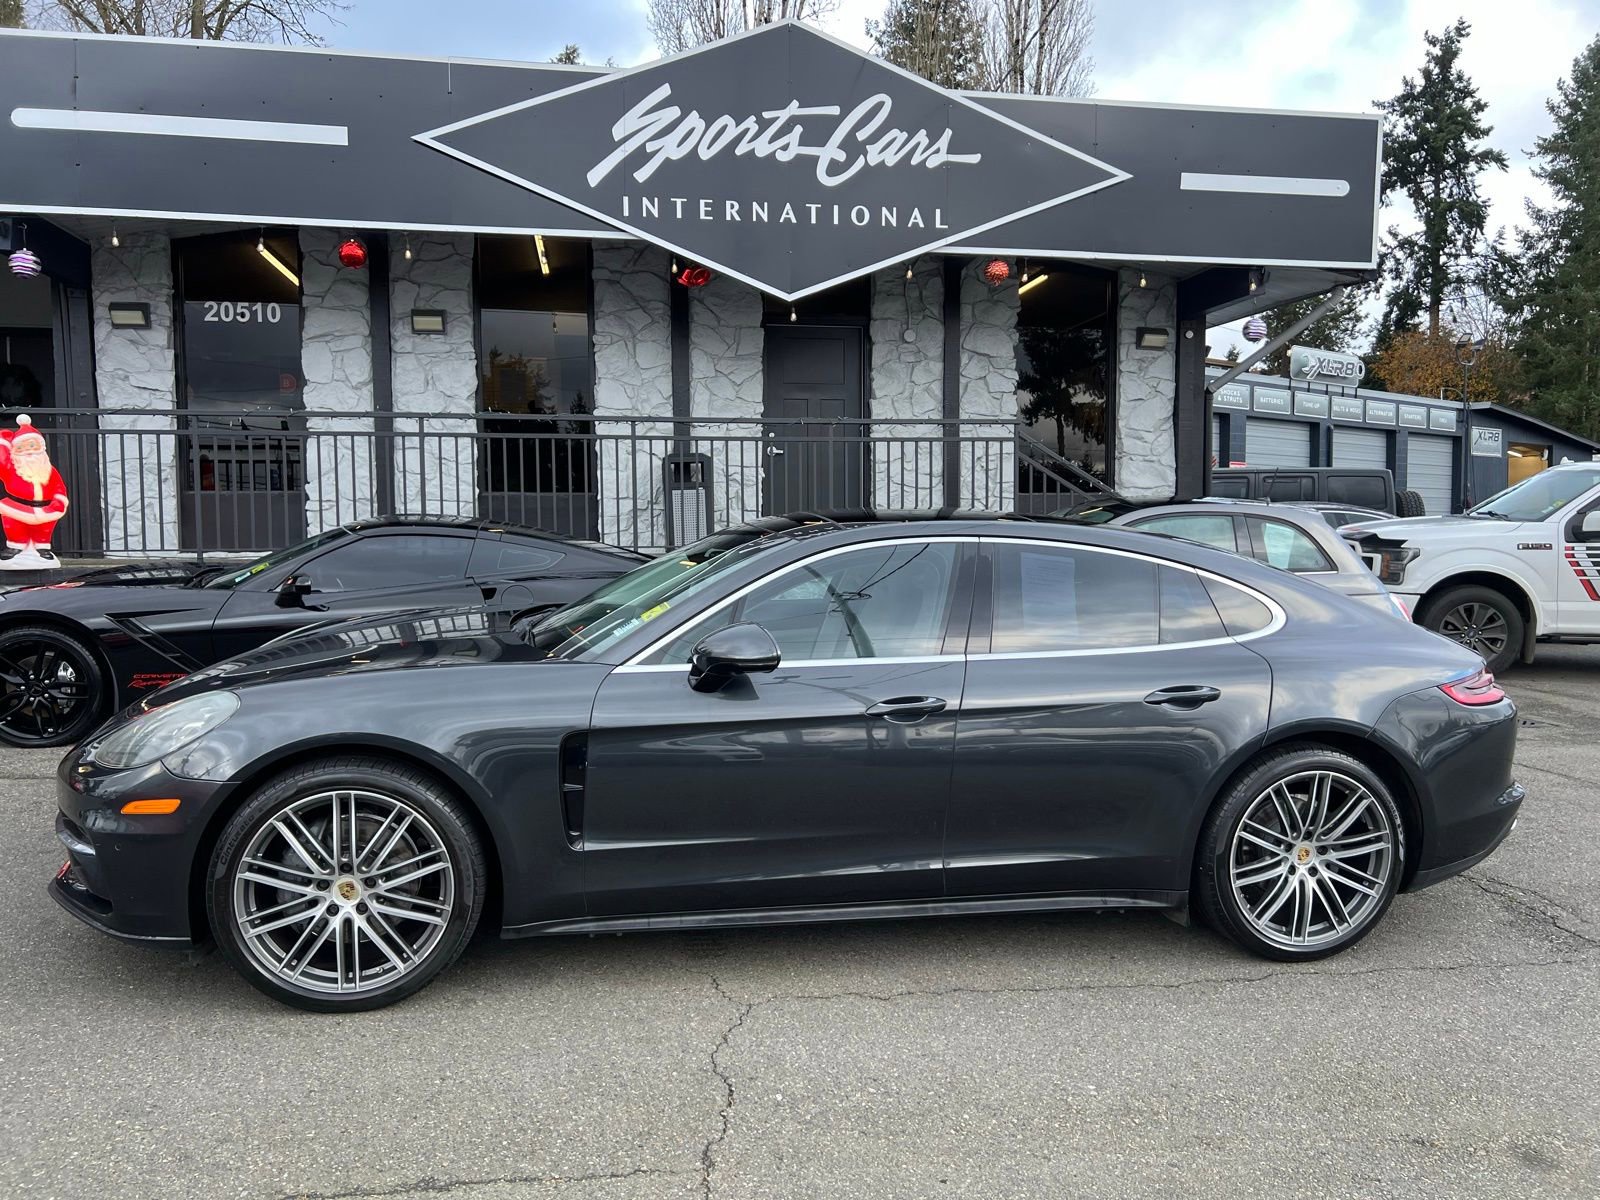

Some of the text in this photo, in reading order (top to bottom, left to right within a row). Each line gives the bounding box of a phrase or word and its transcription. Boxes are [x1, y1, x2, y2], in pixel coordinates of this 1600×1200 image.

[586, 83, 982, 188] Sports Cars
[622, 195, 949, 229] INTERNATIONAL
[203, 301, 281, 323] 20510
[1307, 356, 1355, 379] XLR8
[1220, 389, 1241, 397] SHOCKS
[1223, 395, 1243, 404] STRUTS
[1260, 396, 1284, 405] BATTERIES
[1474, 431, 1500, 445] XLR8
